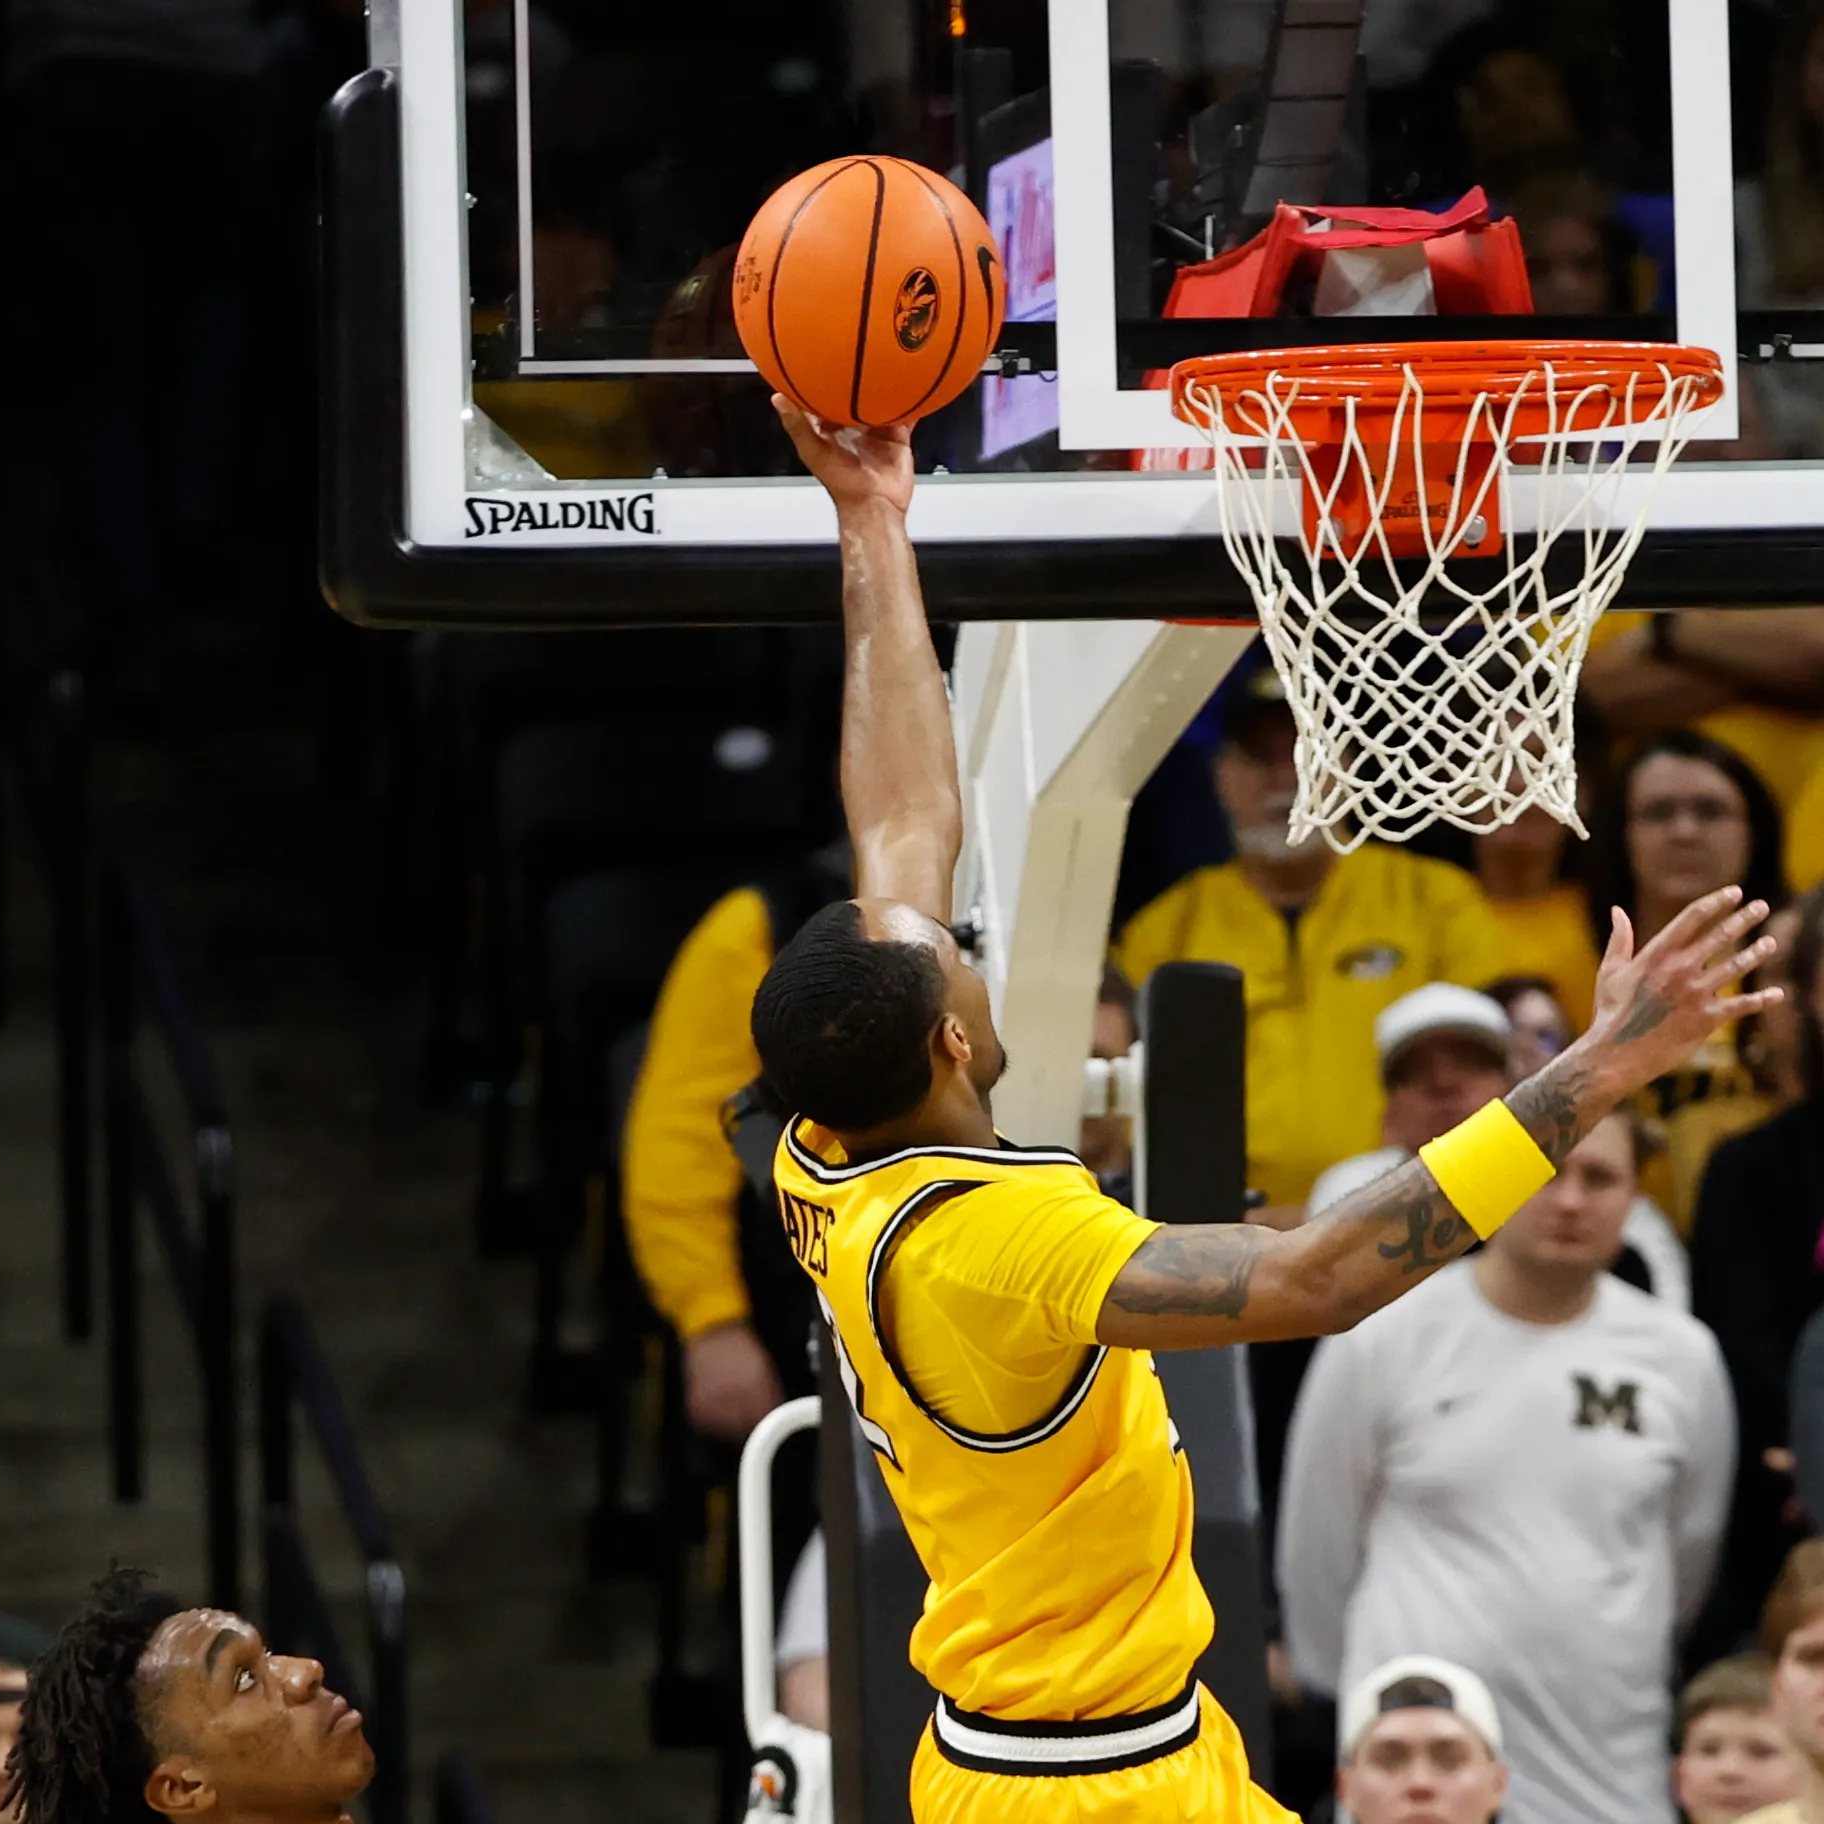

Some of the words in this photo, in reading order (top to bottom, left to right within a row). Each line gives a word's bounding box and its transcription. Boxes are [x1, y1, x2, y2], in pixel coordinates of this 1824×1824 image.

[464, 493, 655, 539] SPALDING
[777, 1188, 835, 1279] ATES
[1571, 1371, 1644, 1435] M
